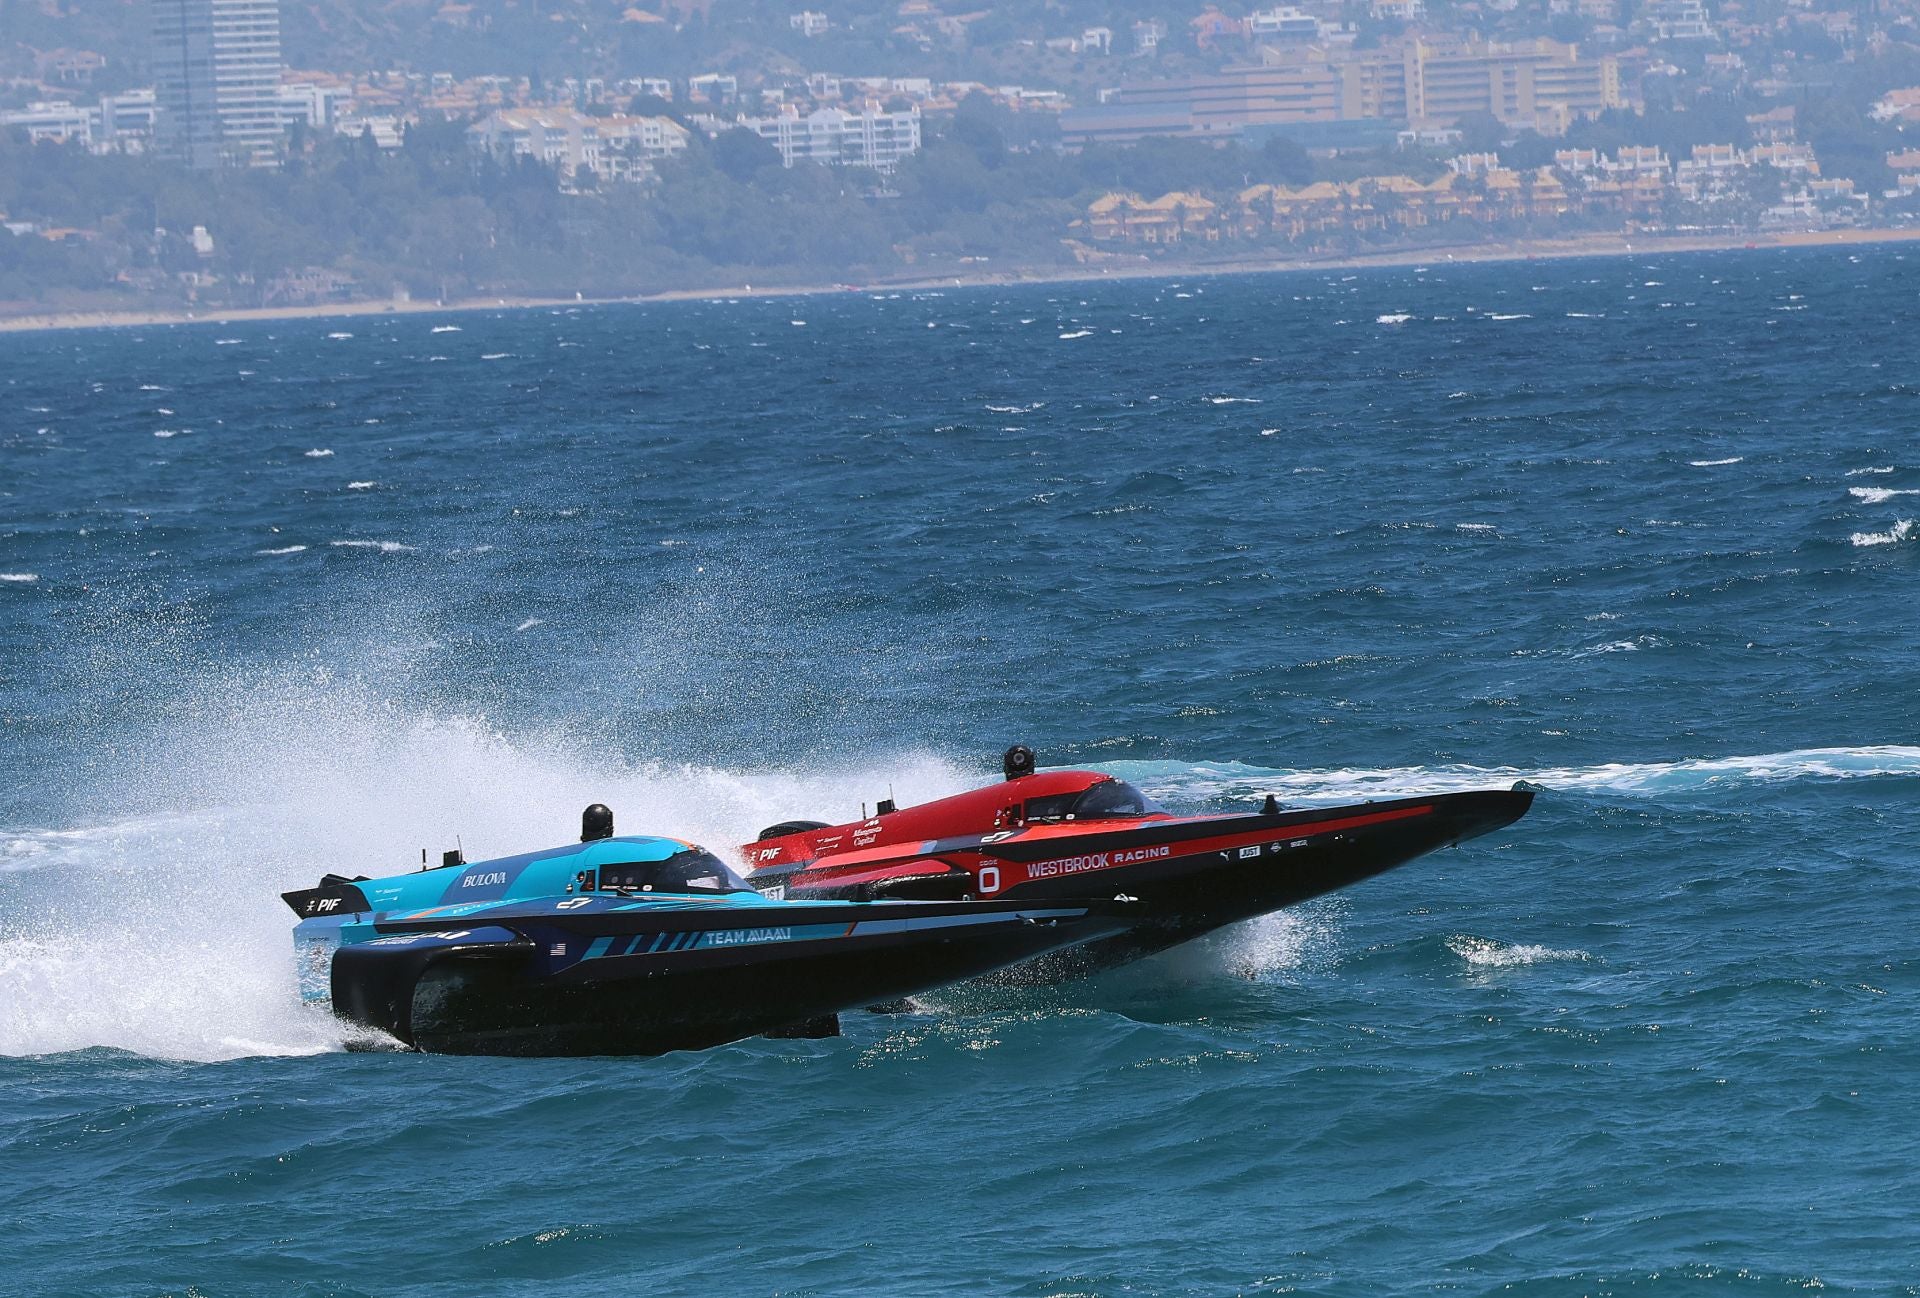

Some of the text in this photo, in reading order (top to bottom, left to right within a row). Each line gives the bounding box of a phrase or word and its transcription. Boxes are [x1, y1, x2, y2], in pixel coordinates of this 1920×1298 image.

[759, 847, 782, 861] PIF
[1241, 847, 1259, 858] JUST
[1027, 846, 1170, 878] WESTBROOK RACING
[462, 871, 507, 888] BULOVA
[317, 898, 342, 912] PIF
[707, 930, 744, 945] TEAM
